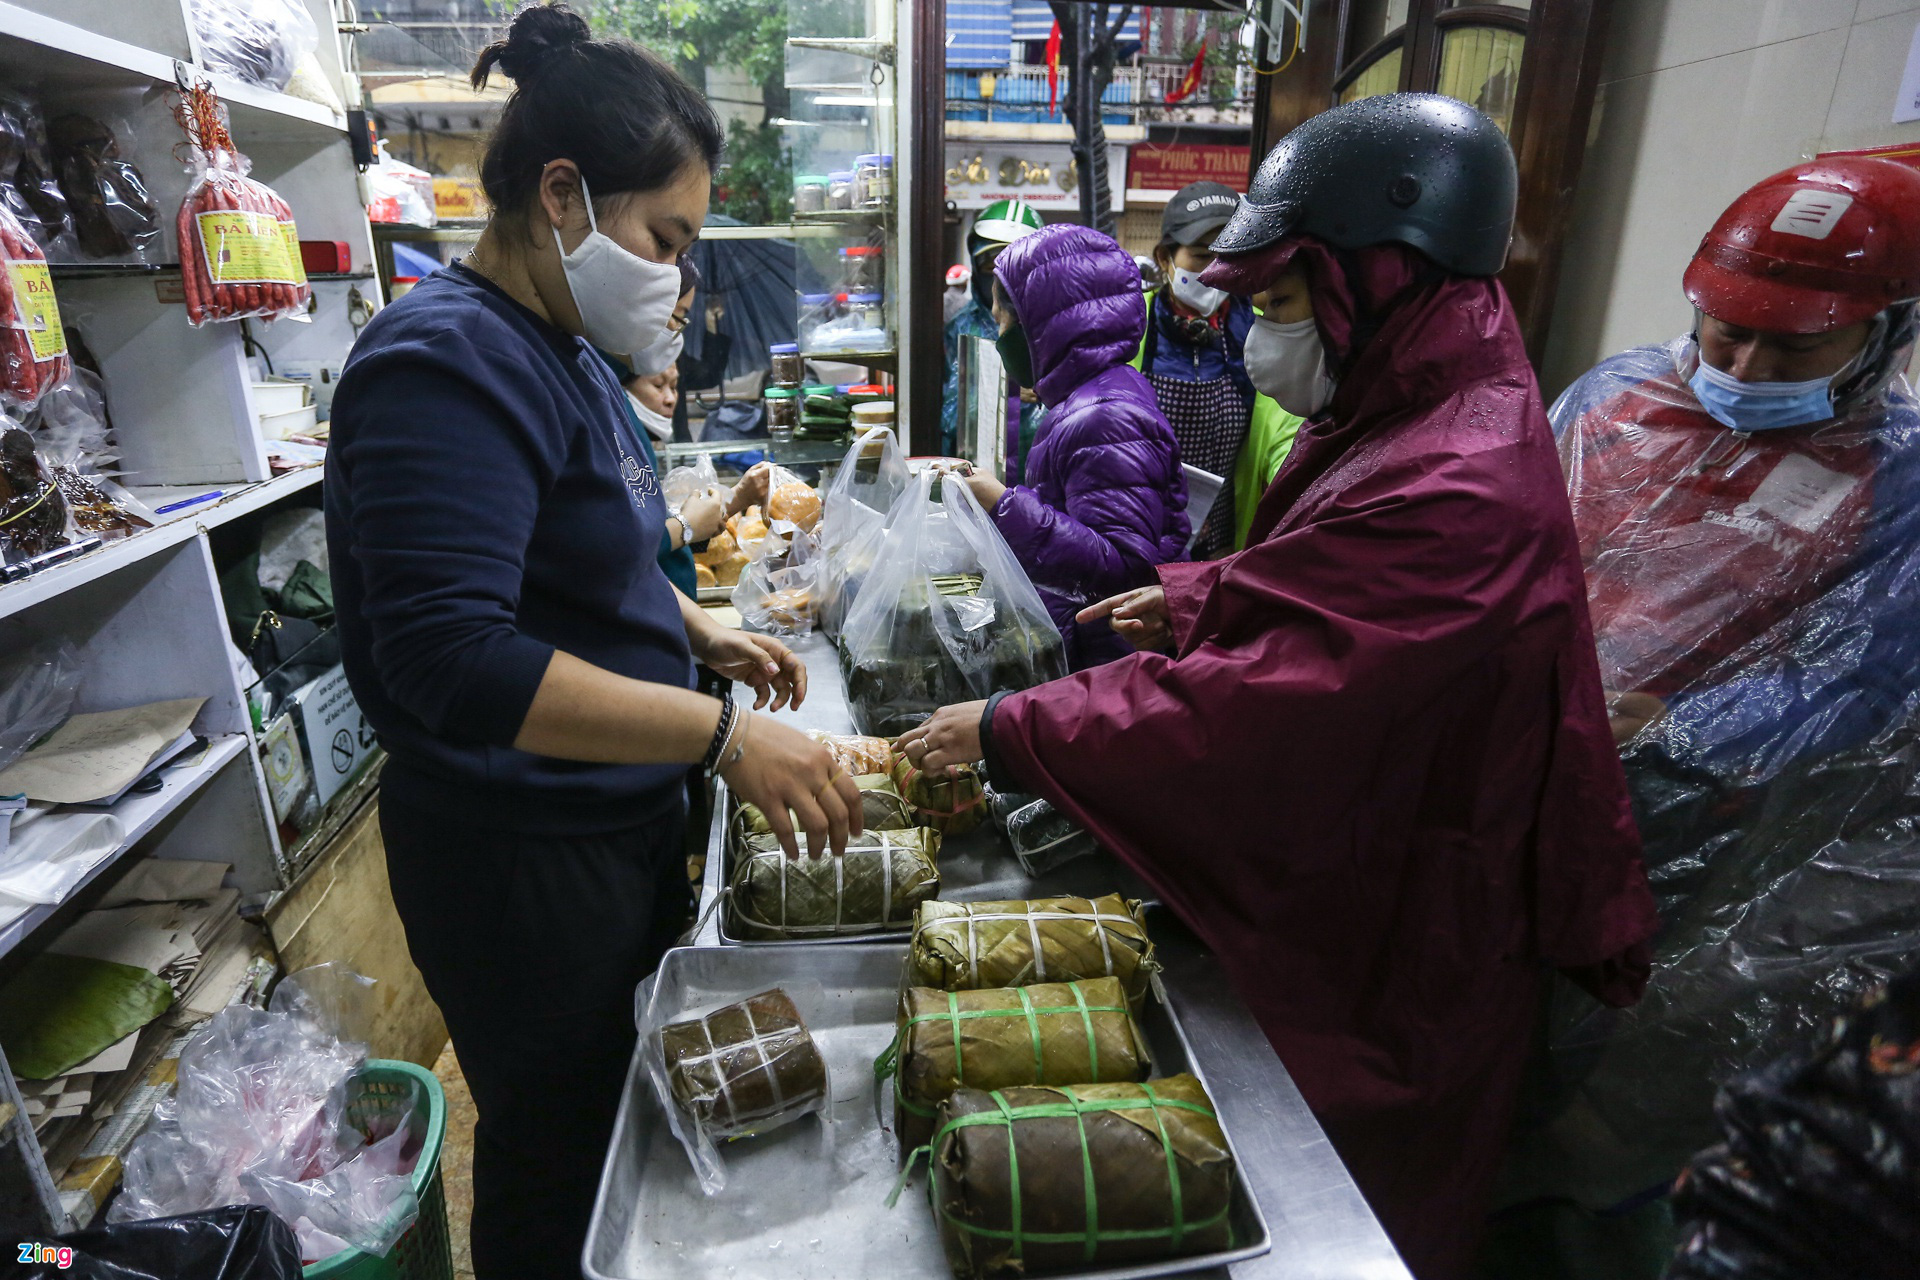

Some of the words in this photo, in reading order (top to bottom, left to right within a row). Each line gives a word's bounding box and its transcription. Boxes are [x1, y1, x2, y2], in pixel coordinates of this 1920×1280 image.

[1160, 147, 1200, 171] PHÚC
[1198, 194, 1238, 208] YAMAHA
[26, 278, 51, 293] BÀ
